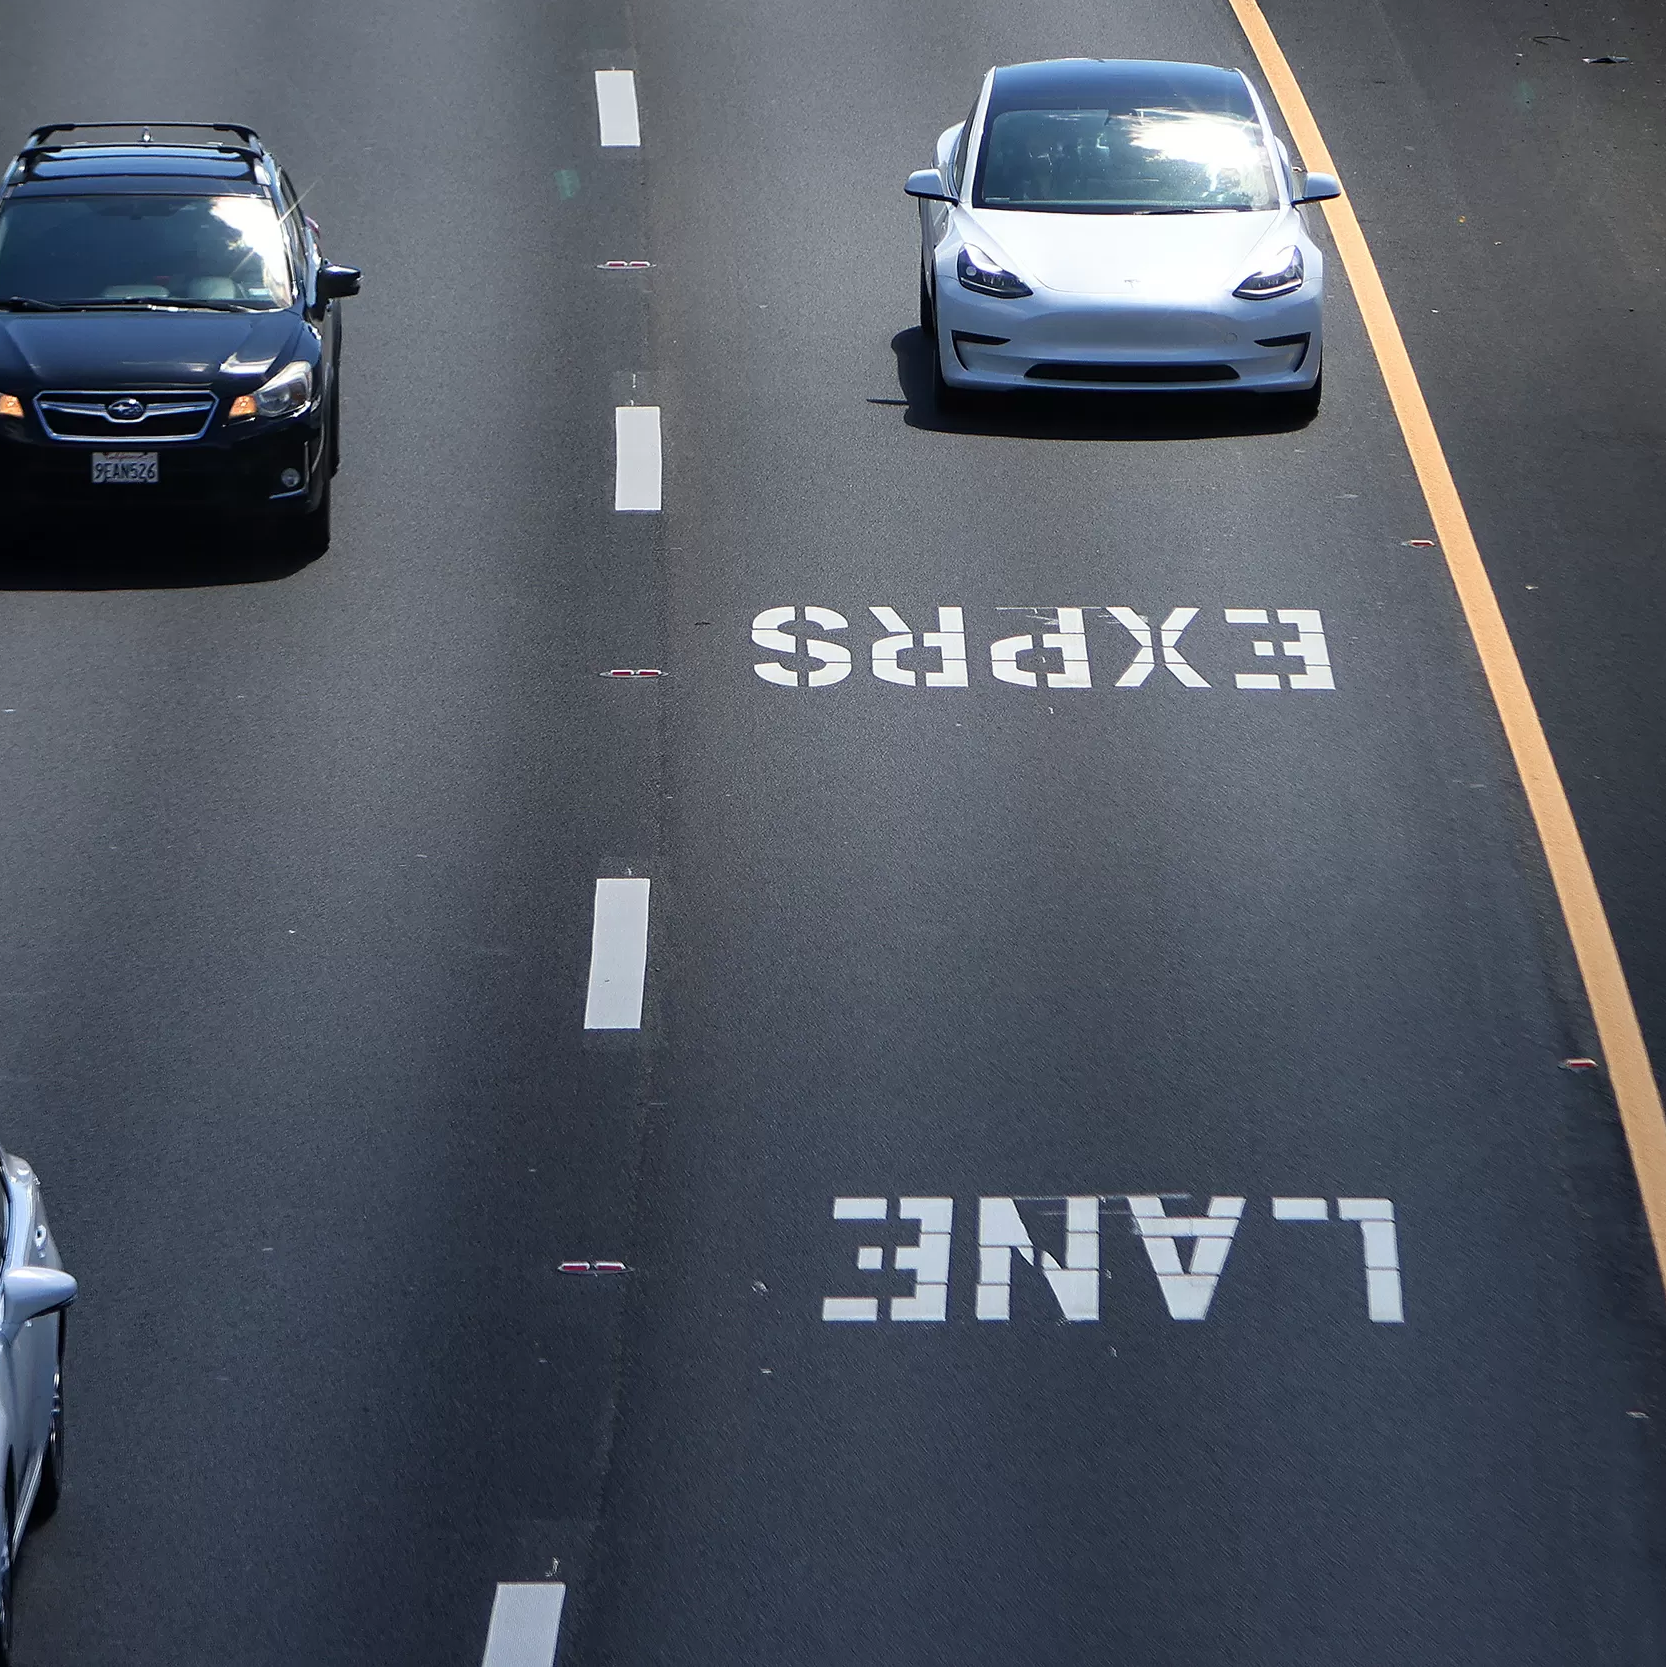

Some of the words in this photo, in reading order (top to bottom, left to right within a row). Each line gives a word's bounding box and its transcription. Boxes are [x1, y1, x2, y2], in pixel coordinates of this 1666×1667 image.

[94, 462, 157, 479] 9EAN526
[751, 605, 1337, 690] EXPRS
[822, 1196, 1405, 1323] LANE
